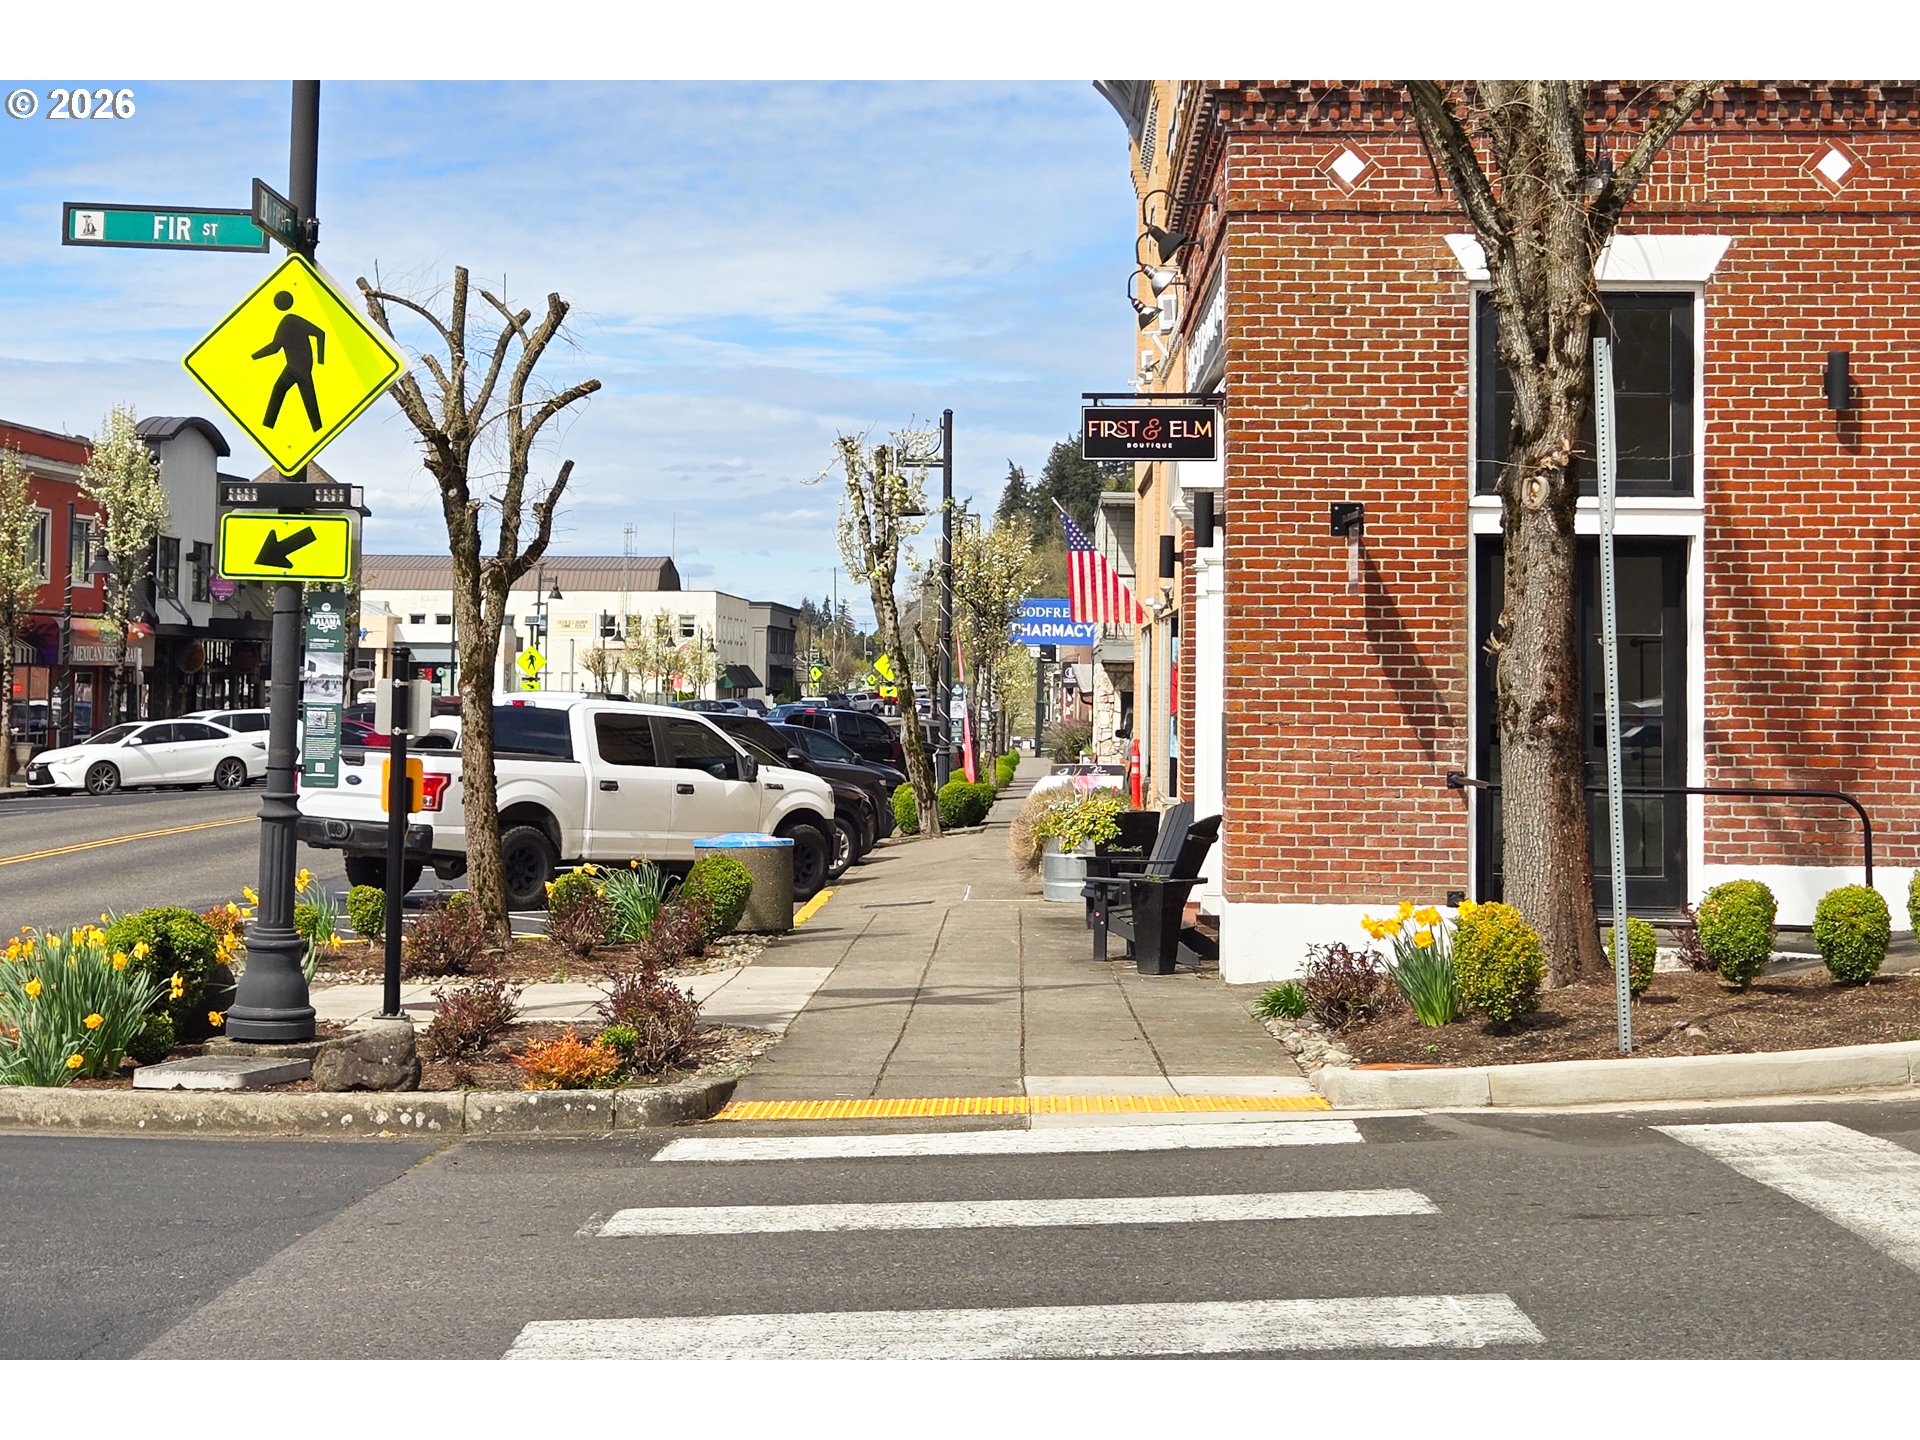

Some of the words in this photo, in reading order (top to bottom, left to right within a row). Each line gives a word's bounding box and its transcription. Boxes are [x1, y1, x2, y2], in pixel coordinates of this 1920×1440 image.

[153, 215, 192, 241] FIR
[203, 222, 218, 237] ST
[1088, 420, 1140, 438] FIRST
[1142, 418, 1162, 440] &
[1169, 420, 1212, 438] ELM
[1016, 606, 1070, 618] GODFRE
[1012, 622, 1095, 638] PHARMACY
[73, 645, 102, 661] MEXICAN
